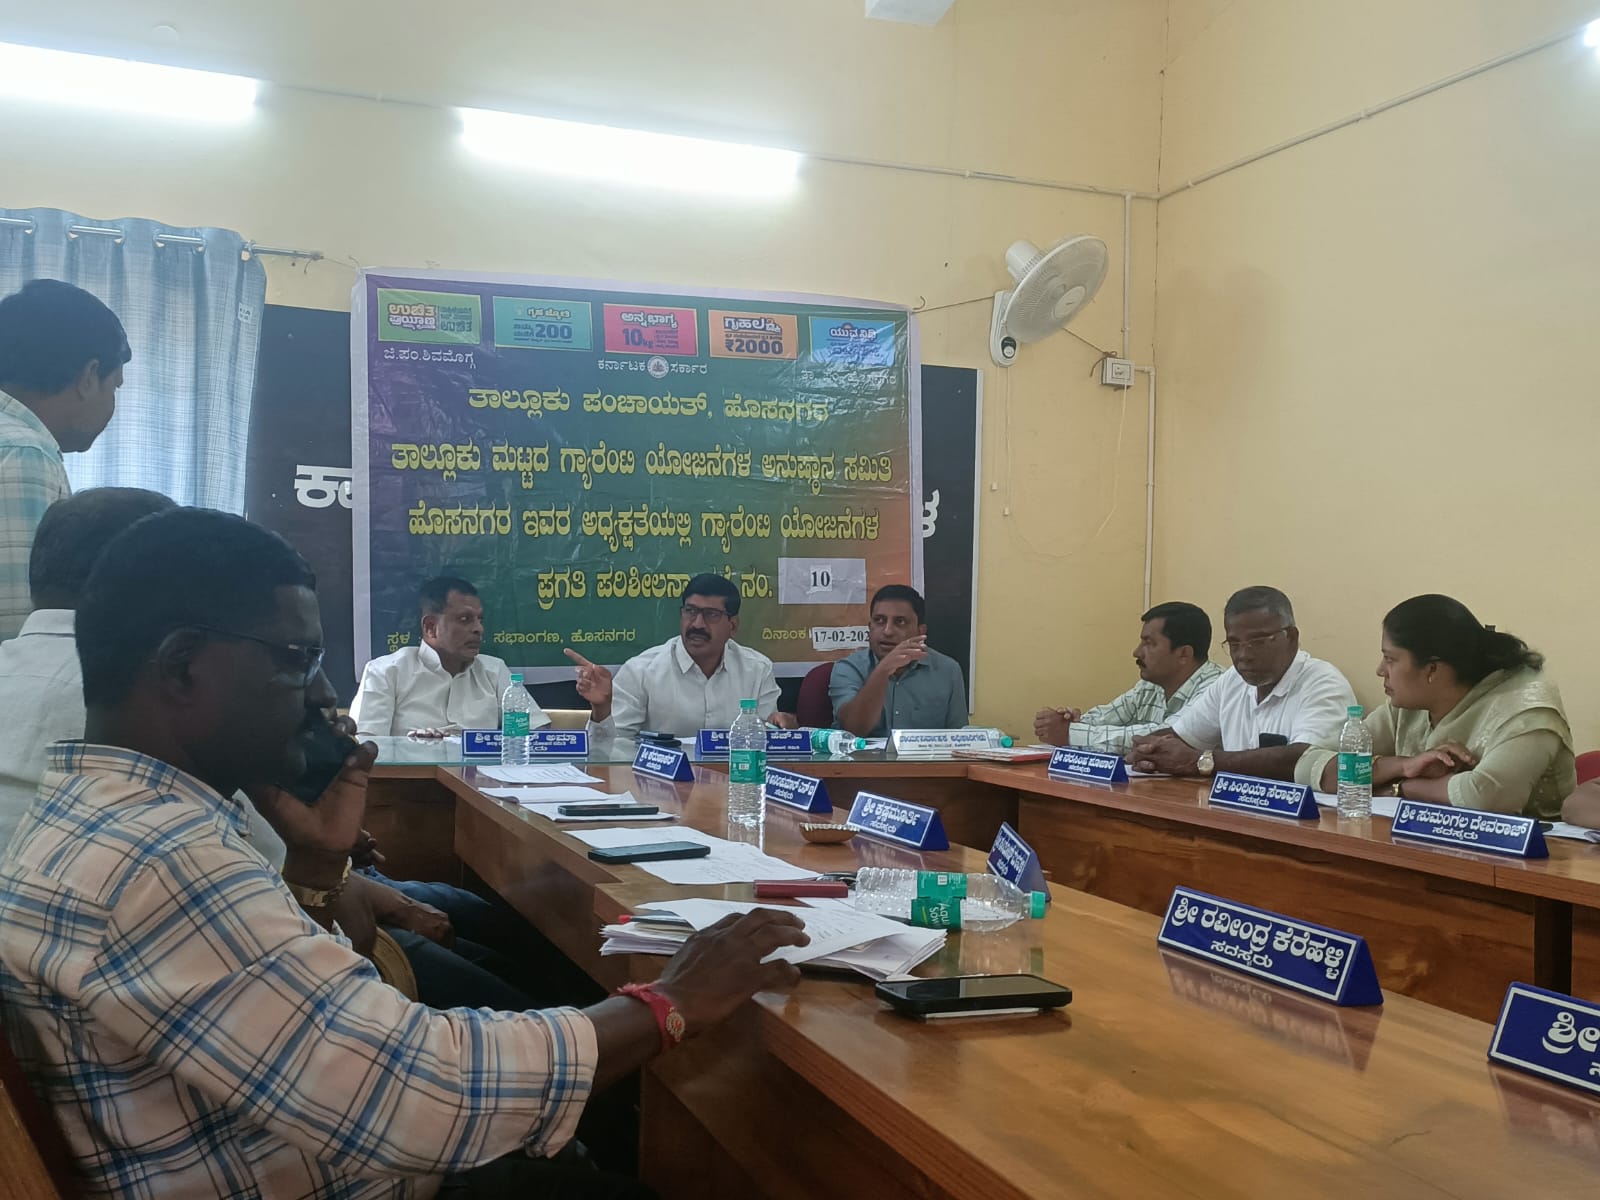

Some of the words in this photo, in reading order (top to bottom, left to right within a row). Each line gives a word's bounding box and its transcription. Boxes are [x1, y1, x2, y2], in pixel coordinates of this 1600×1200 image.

[534, 323, 573, 340] 200
[725, 339, 784, 355] ₹2000
[597, 359, 647, 372] ಕರ್ನಾಟಕ
[670, 361, 708, 374] ಸರ್ಕಾರ
[468, 386, 570, 419] ತಾಲ್ಲೂಕು
[724, 393, 829, 422] ಹೊಸನಗರ
[391, 437, 481, 482] ತಾಲ್ಲೂಕು
[492, 440, 549, 489] ಮಟ್ಟದ
[560, 441, 636, 490] ಗ್ಯಾರೆಂಟಿ
[645, 443, 751, 478] ಯೋಜನೆಗಳ
[761, 447, 835, 496] ಅನುಷ್ಠಾನ
[844, 450, 893, 482] ಸಮಿತಿ
[408, 500, 512, 535] ಹೊಸನಗರ
[522, 502, 571, 538] ಇವರ
[582, 503, 692, 552] ಅಧ್ಯಕ್ಷತೆಯಲ್ಲಿ
[701, 504, 771, 553] ಗ್ಯಾರೆಂಟಿ
[780, 506, 880, 540] ಯೋಜನೆಗಳ
[537, 566, 587, 610] ಪ್ರಗತಿ
[741, 568, 774, 598] ನಂ.
[810, 570, 831, 588] 10
[570, 627, 636, 643] ಹೊಸನಗರ
[761, 627, 807, 641] ದಿನಾಂಕ
[814, 629, 870, 643] 17-02-202
[1214, 778, 1229, 793] ಶ್ರೀ
[861, 798, 877, 817] ಶ್ರೀ
[1399, 804, 1417, 824] ಶ್ರೀ
[1416, 808, 1470, 829] ಸುಮಂಗಲ
[1469, 814, 1528, 838] ದೇವರಾಜ್
[1432, 825, 1479, 841] ಸದಸ್ಯರು
[1171, 897, 1199, 927] ಶ್ರೀ
[1200, 904, 1274, 953] ರವೀಂದ್ರ
[1272, 926, 1345, 981] ಕೆರೆಹಳ್ಳಿ
[1210, 938, 1274, 969] ಸದಸ್ಯರು
